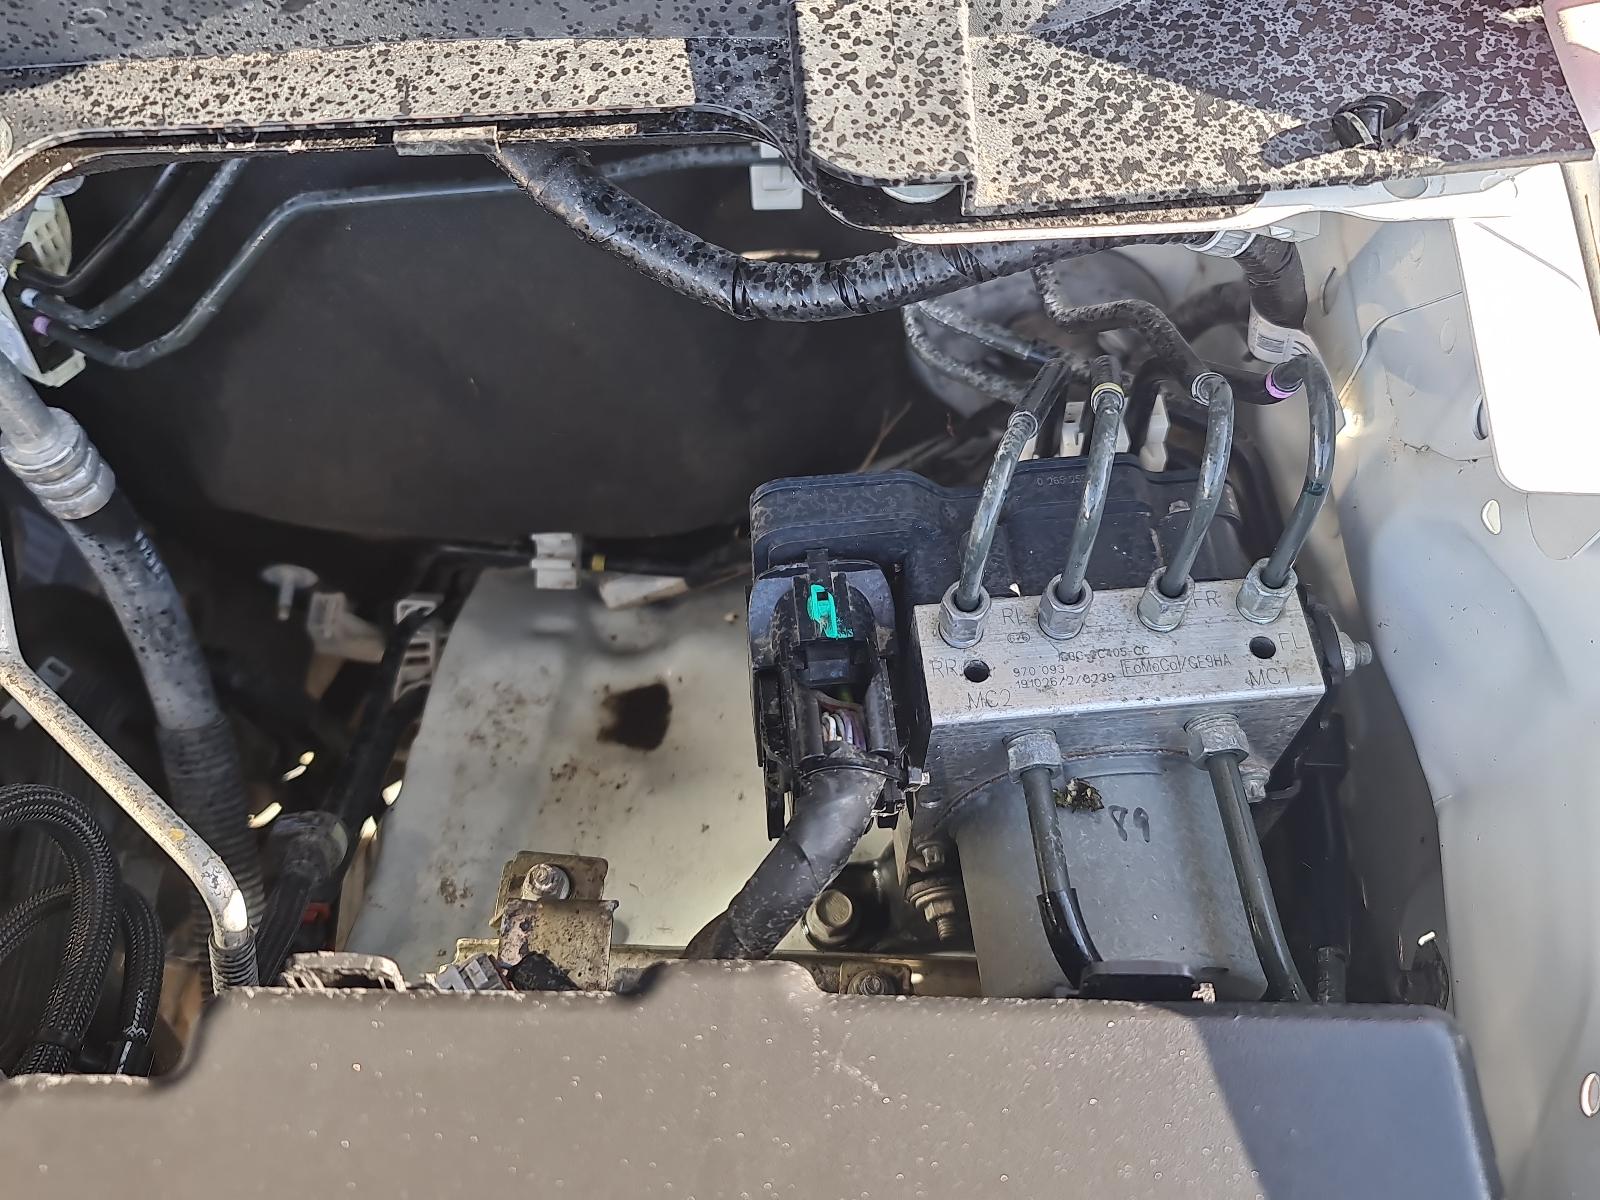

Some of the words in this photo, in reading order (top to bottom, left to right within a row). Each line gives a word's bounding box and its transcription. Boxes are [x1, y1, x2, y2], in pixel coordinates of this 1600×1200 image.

[1001, 608, 1027, 626] RL
[1278, 632, 1305, 651] FL
[931, 659, 958, 679] RR
[1013, 666, 1035, 677] 970
[1041, 664, 1065, 676] 093
[1248, 666, 1292, 687] MC1
[967, 689, 1013, 711] MC2
